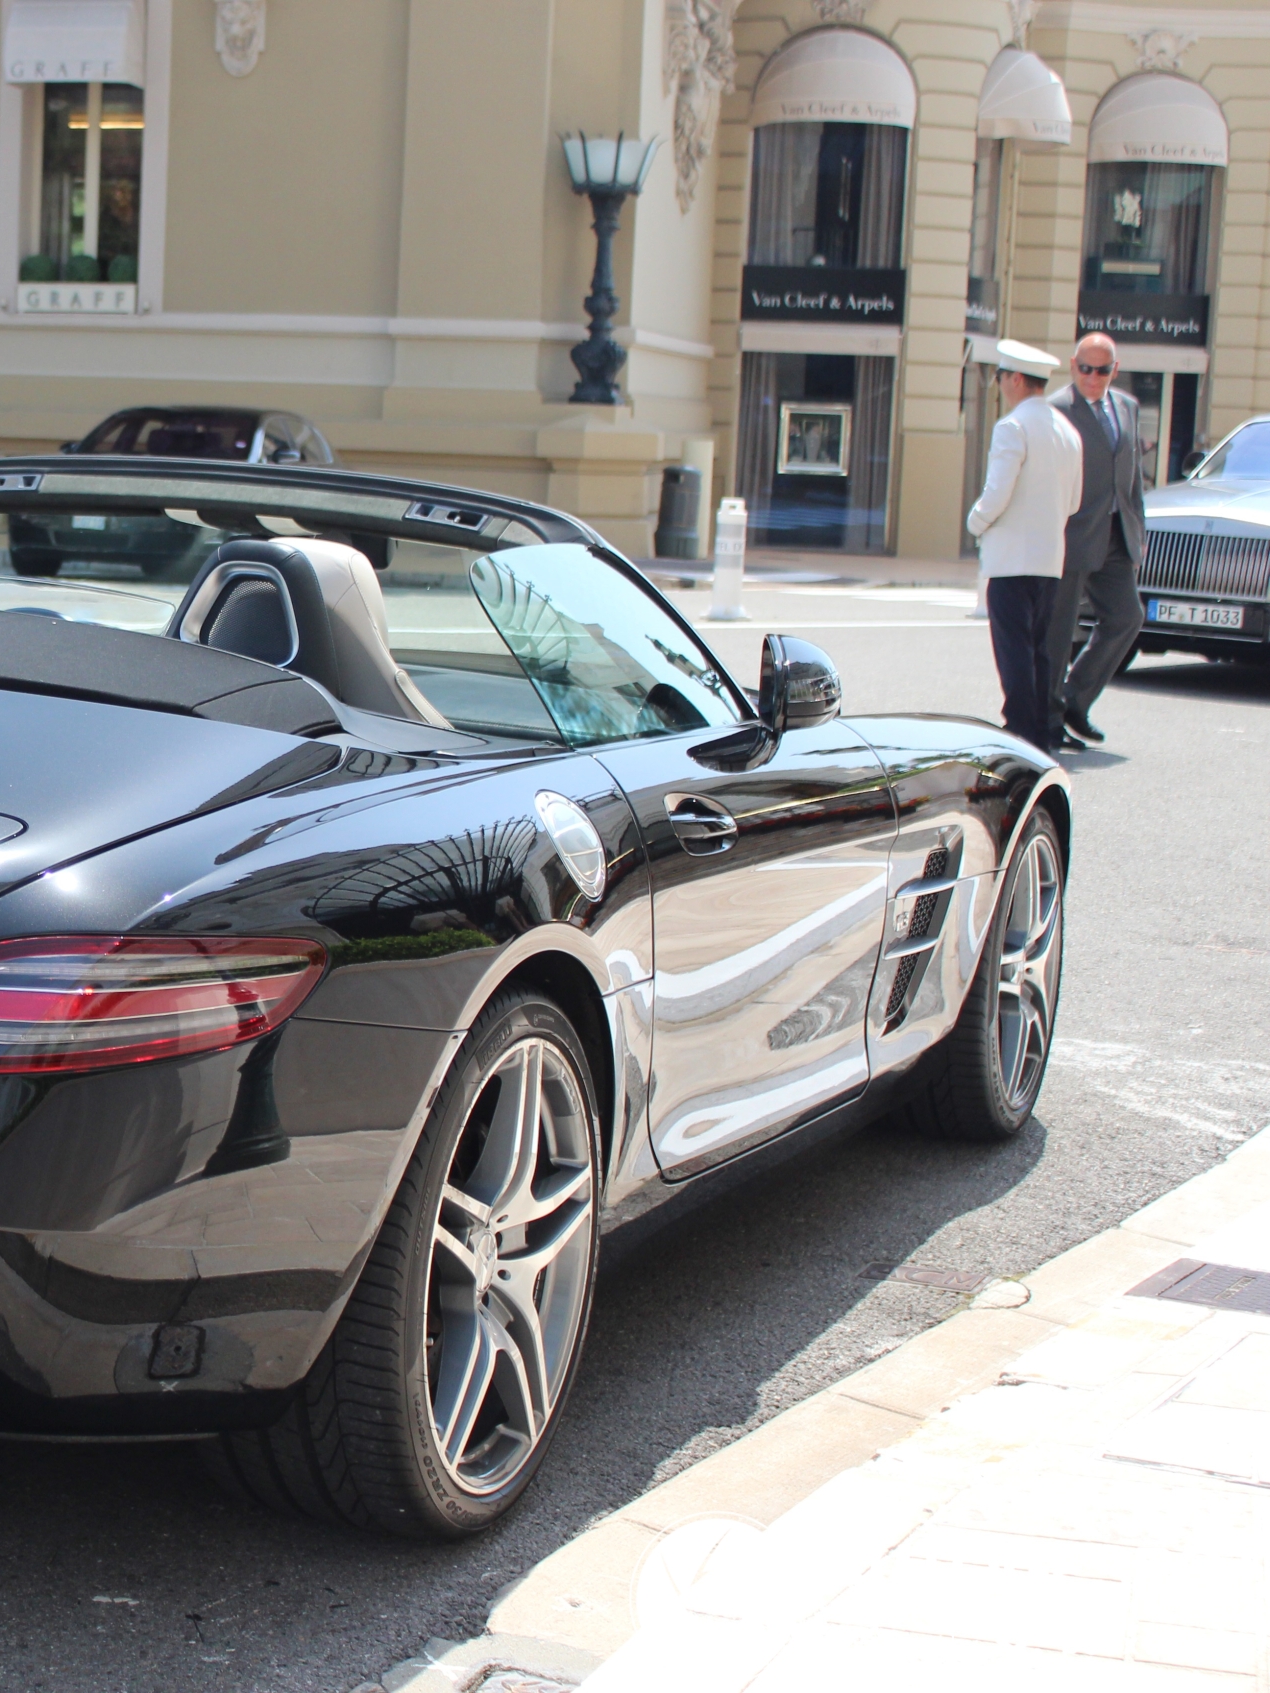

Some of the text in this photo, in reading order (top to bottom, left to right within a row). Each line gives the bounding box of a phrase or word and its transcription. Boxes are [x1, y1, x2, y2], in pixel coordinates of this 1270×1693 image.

[10, 60, 116, 78] GRAFF
[781, 103, 804, 115] Van
[808, 102, 847, 115] Cleef
[1123, 144, 1147, 156] Van
[1150, 143, 1187, 157] Cleef
[26, 290, 125, 308] GRAFF
[752, 290, 894, 315] Van Cleef & Arpels
[1079, 314, 1200, 337] Van Cleef & Arpels
[1158, 604, 1240, 626] PF T 1033
[422, 1456, 450, 1502] ZR20
